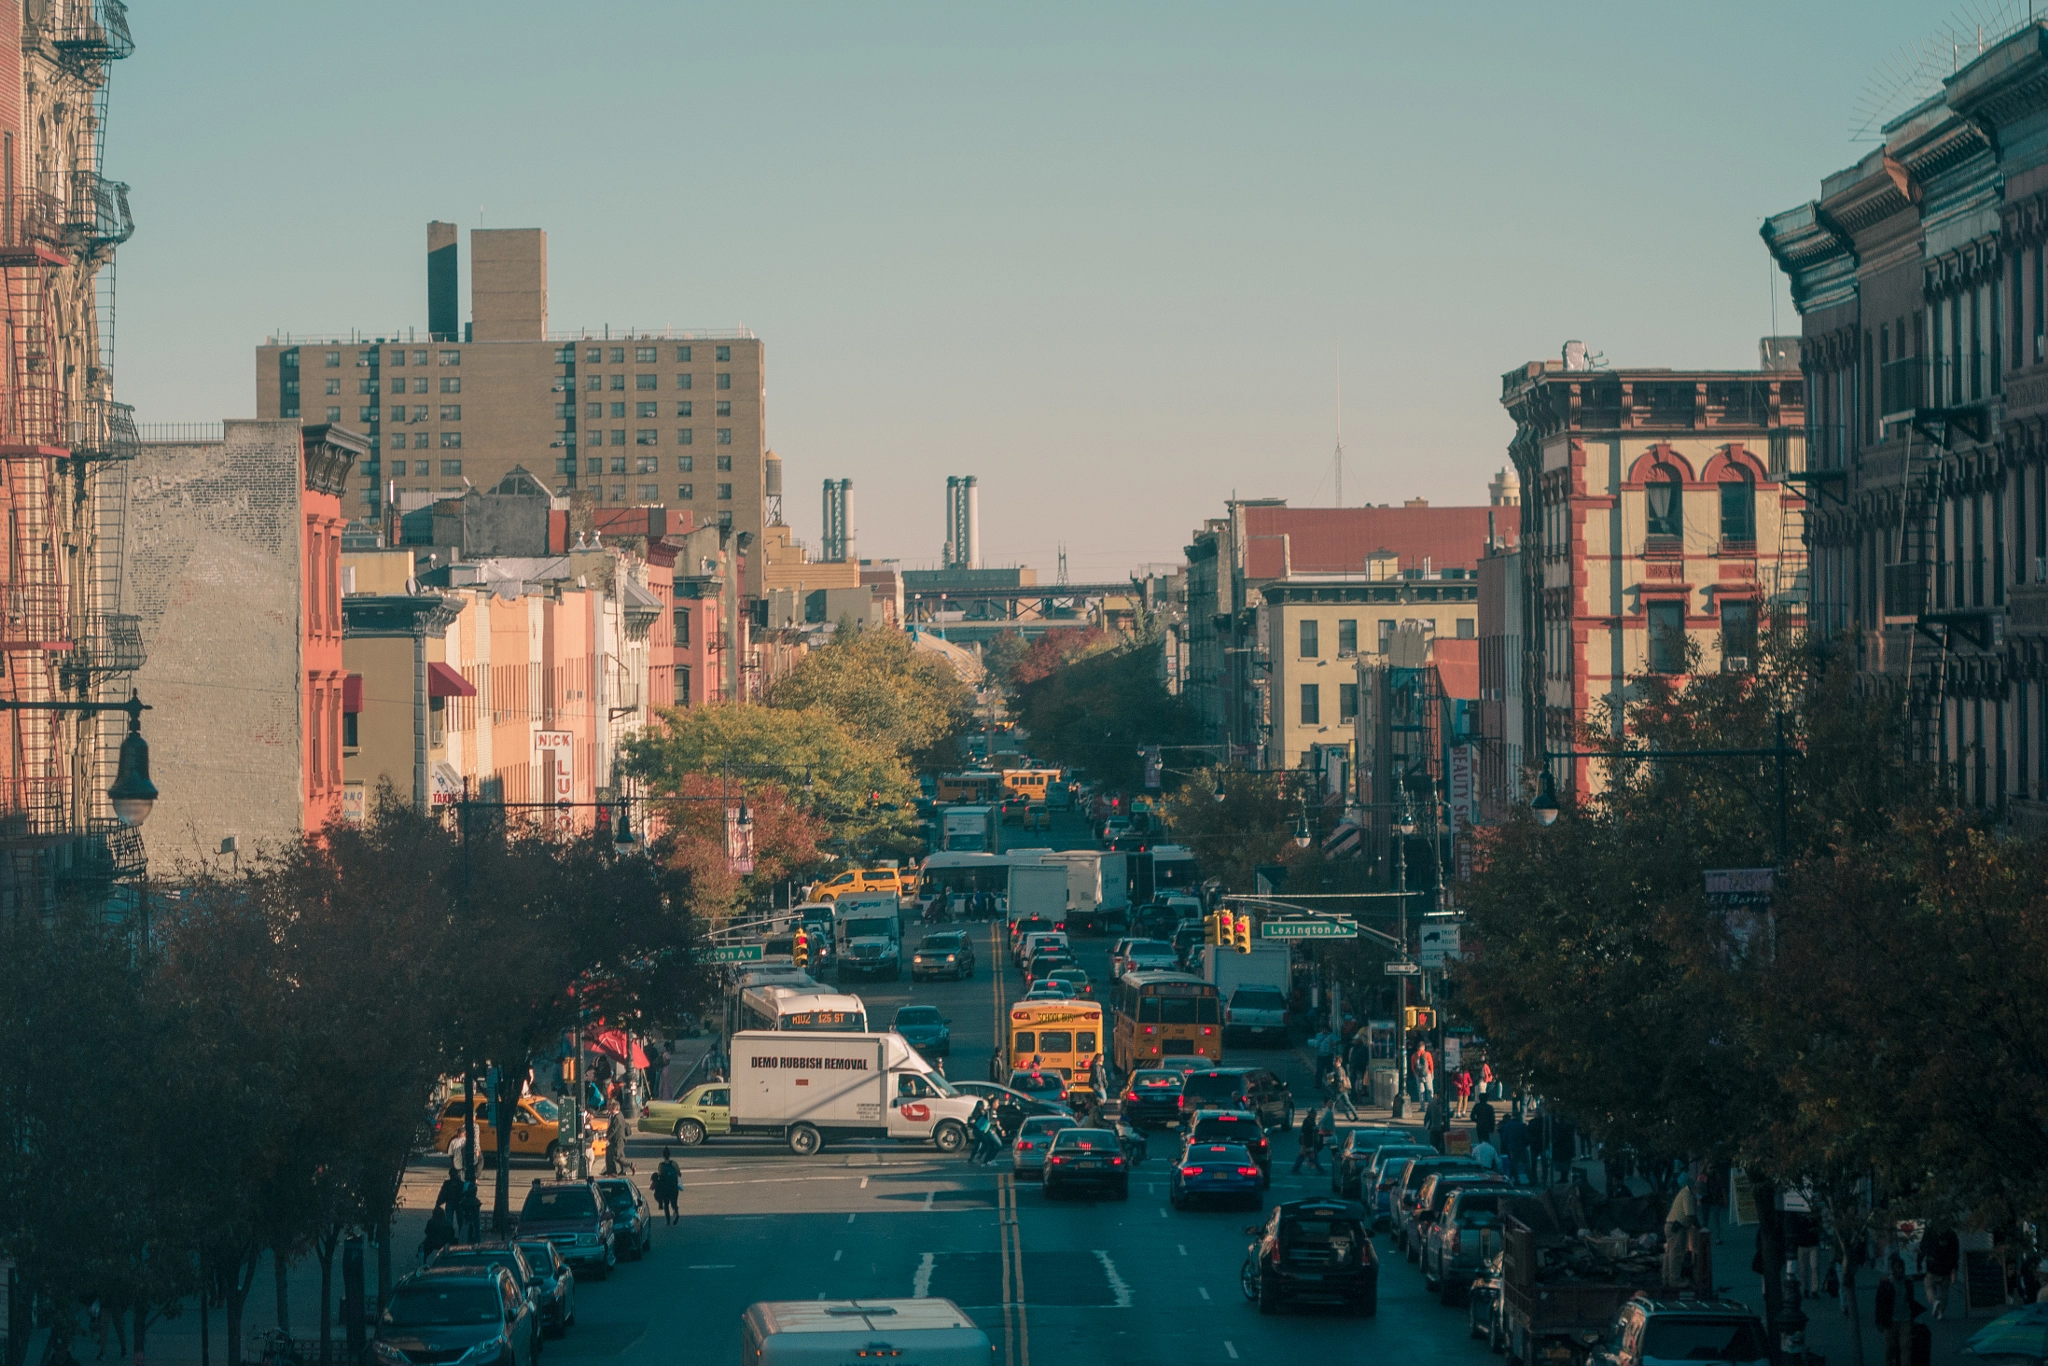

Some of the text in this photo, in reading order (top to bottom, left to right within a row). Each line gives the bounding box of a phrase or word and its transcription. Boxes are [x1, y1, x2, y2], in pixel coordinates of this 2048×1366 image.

[538, 735, 570, 747] NICK
[1452, 746, 1469, 800] BEAUTY
[1271, 924, 1348, 937] Lexington Av
[737, 949, 753, 959] Av
[818, 1012, 832, 1024] 125
[834, 1012, 845, 1023] ST
[751, 1056, 868, 1071] DEMO RUBBISH REMOVAL
